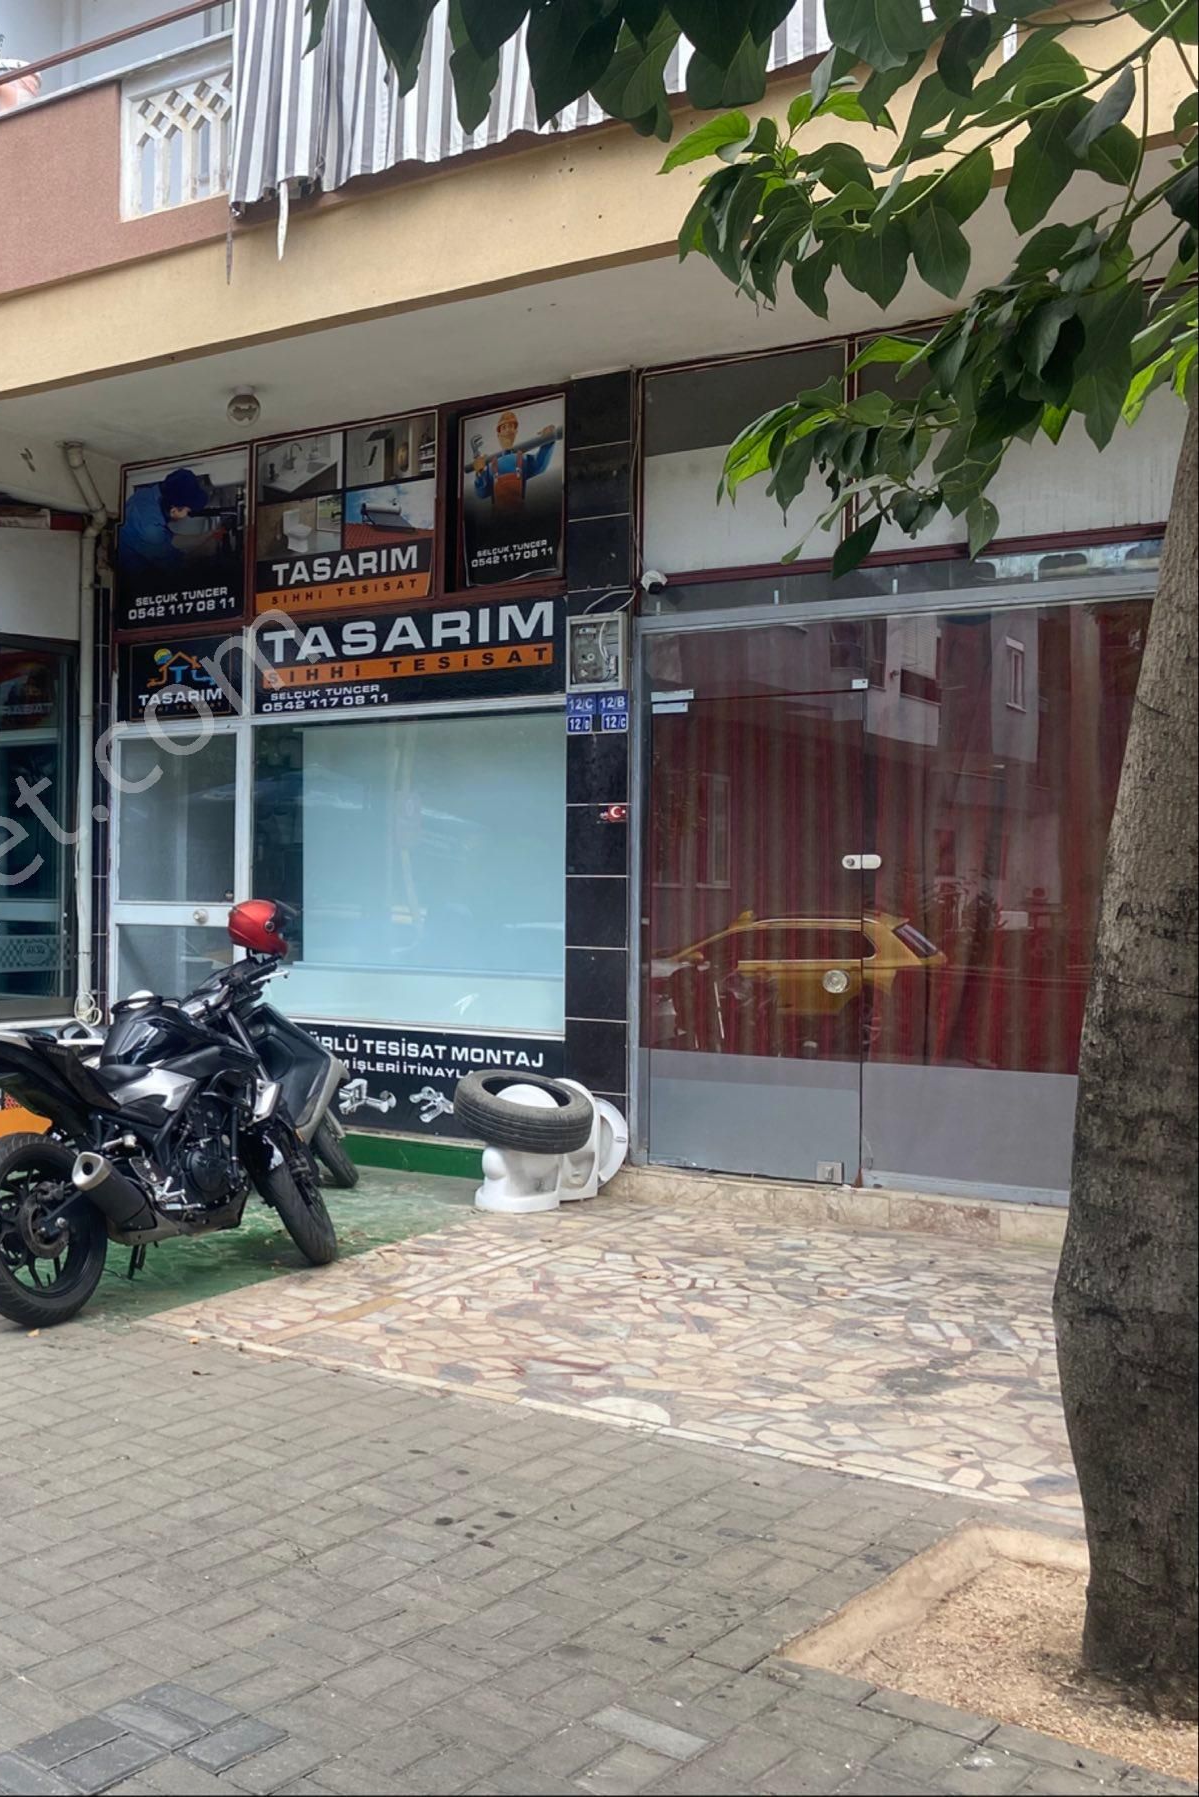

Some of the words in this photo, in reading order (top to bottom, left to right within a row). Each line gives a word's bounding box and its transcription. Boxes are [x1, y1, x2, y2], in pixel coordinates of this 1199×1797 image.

[512, 539, 547, 550] TUNCER
[272, 545, 418, 586] TASARIM
[471, 556, 500, 568] 0542
[502, 552, 521, 562] 117
[523, 550, 538, 559] 08
[542, 546, 553, 556] 11
[135, 592, 178, 607] SELÇUK
[182, 586, 228, 600] TUNCER
[128, 606, 165, 620] 0542
[168, 602, 194, 615] 117
[196, 599, 216, 612] 08
[219, 597, 235, 609] 11
[263, 601, 554, 663] TASARIM
[138, 687, 223, 707] TASARIM
[262, 700, 306, 712] 0542
[309, 697, 338, 708] 117
[342, 694, 366, 706] 08
[370, 693, 390, 703] 11
[271, 688, 321, 701] SELÇUK
[325, 684, 380, 697] TUNCER
[600, 695, 626, 709] 12/B
[568, 697, 593, 711] 12/C
[362, 1038, 448, 1060] TESİSAT
[451, 1046, 544, 1068] MONTAJ
[352, 1059, 401, 1074] İŞLERİ
